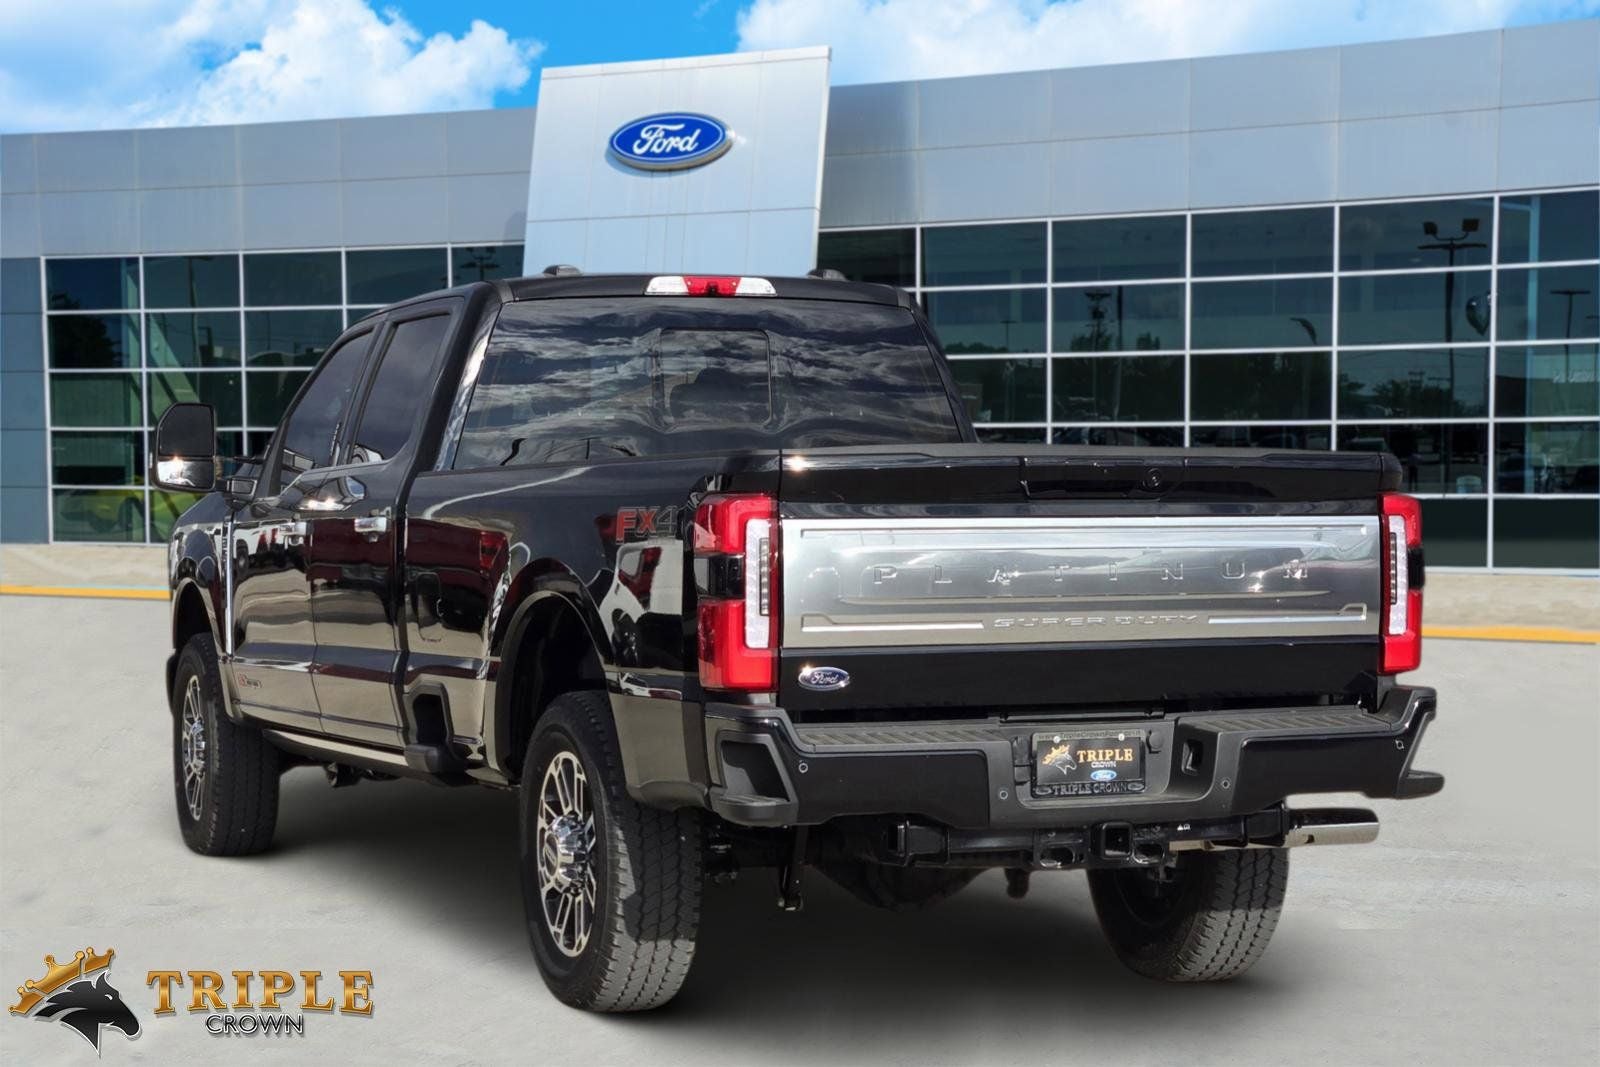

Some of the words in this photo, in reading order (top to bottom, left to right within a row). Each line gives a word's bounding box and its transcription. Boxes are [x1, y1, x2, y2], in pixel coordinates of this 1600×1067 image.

[633, 123, 701, 155] Ford
[616, 505, 678, 545] FX4
[873, 560, 1308, 585] PLATINUM
[994, 617, 1106, 628] SUPER
[1114, 614, 1199, 626] DUTY
[1077, 748, 1134, 763] TRIPLE
[1053, 783, 1092, 795] TRIPLE
[1093, 781, 1128, 793] CROWN
